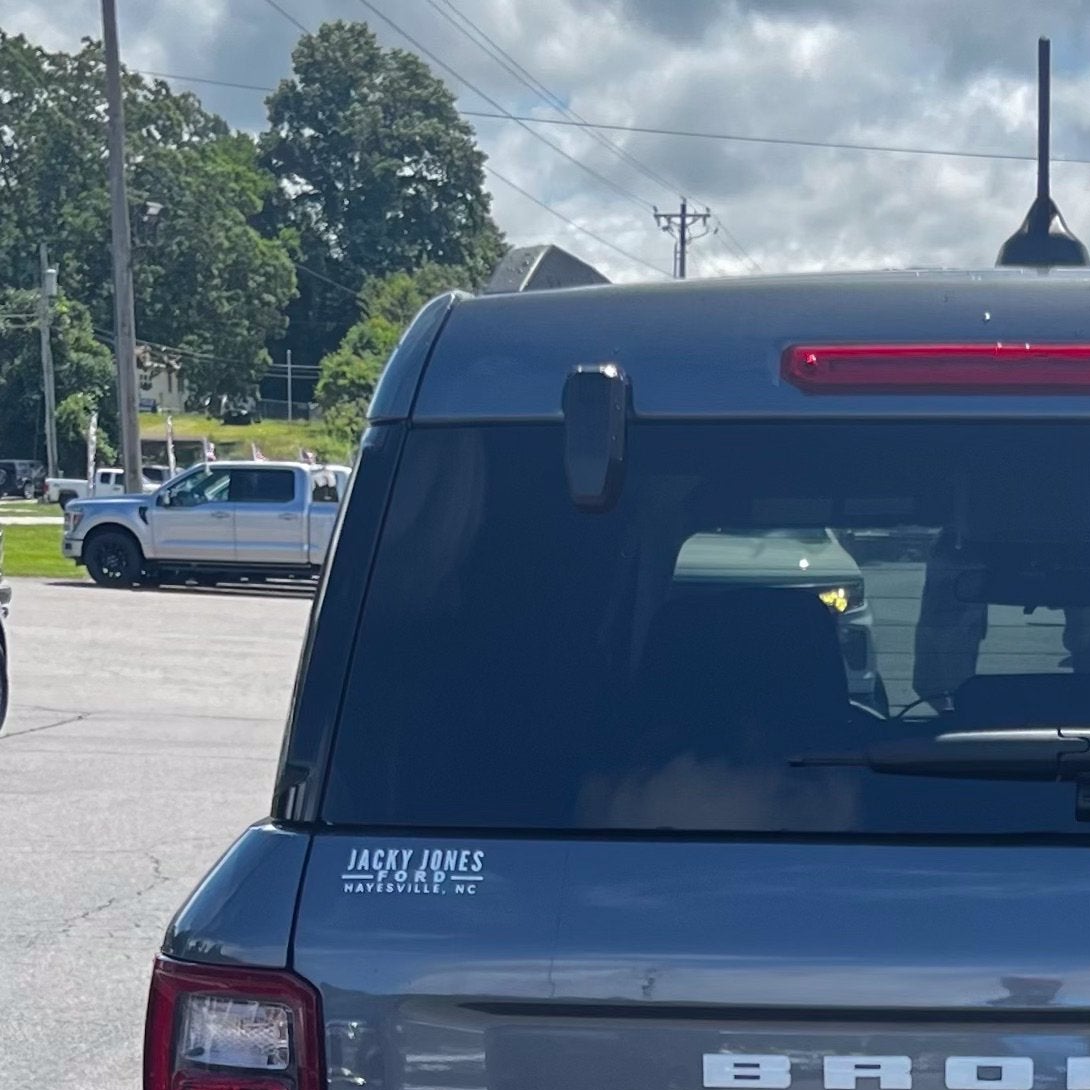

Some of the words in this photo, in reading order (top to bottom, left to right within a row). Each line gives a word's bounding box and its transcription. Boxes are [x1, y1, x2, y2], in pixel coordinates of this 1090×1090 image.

[347, 849, 414, 871] JACKY
[419, 849, 485, 872] JONES
[377, 870, 446, 883] FORD
[343, 882, 446, 895] HAYESVILLE,
[455, 884, 477, 895] NC
